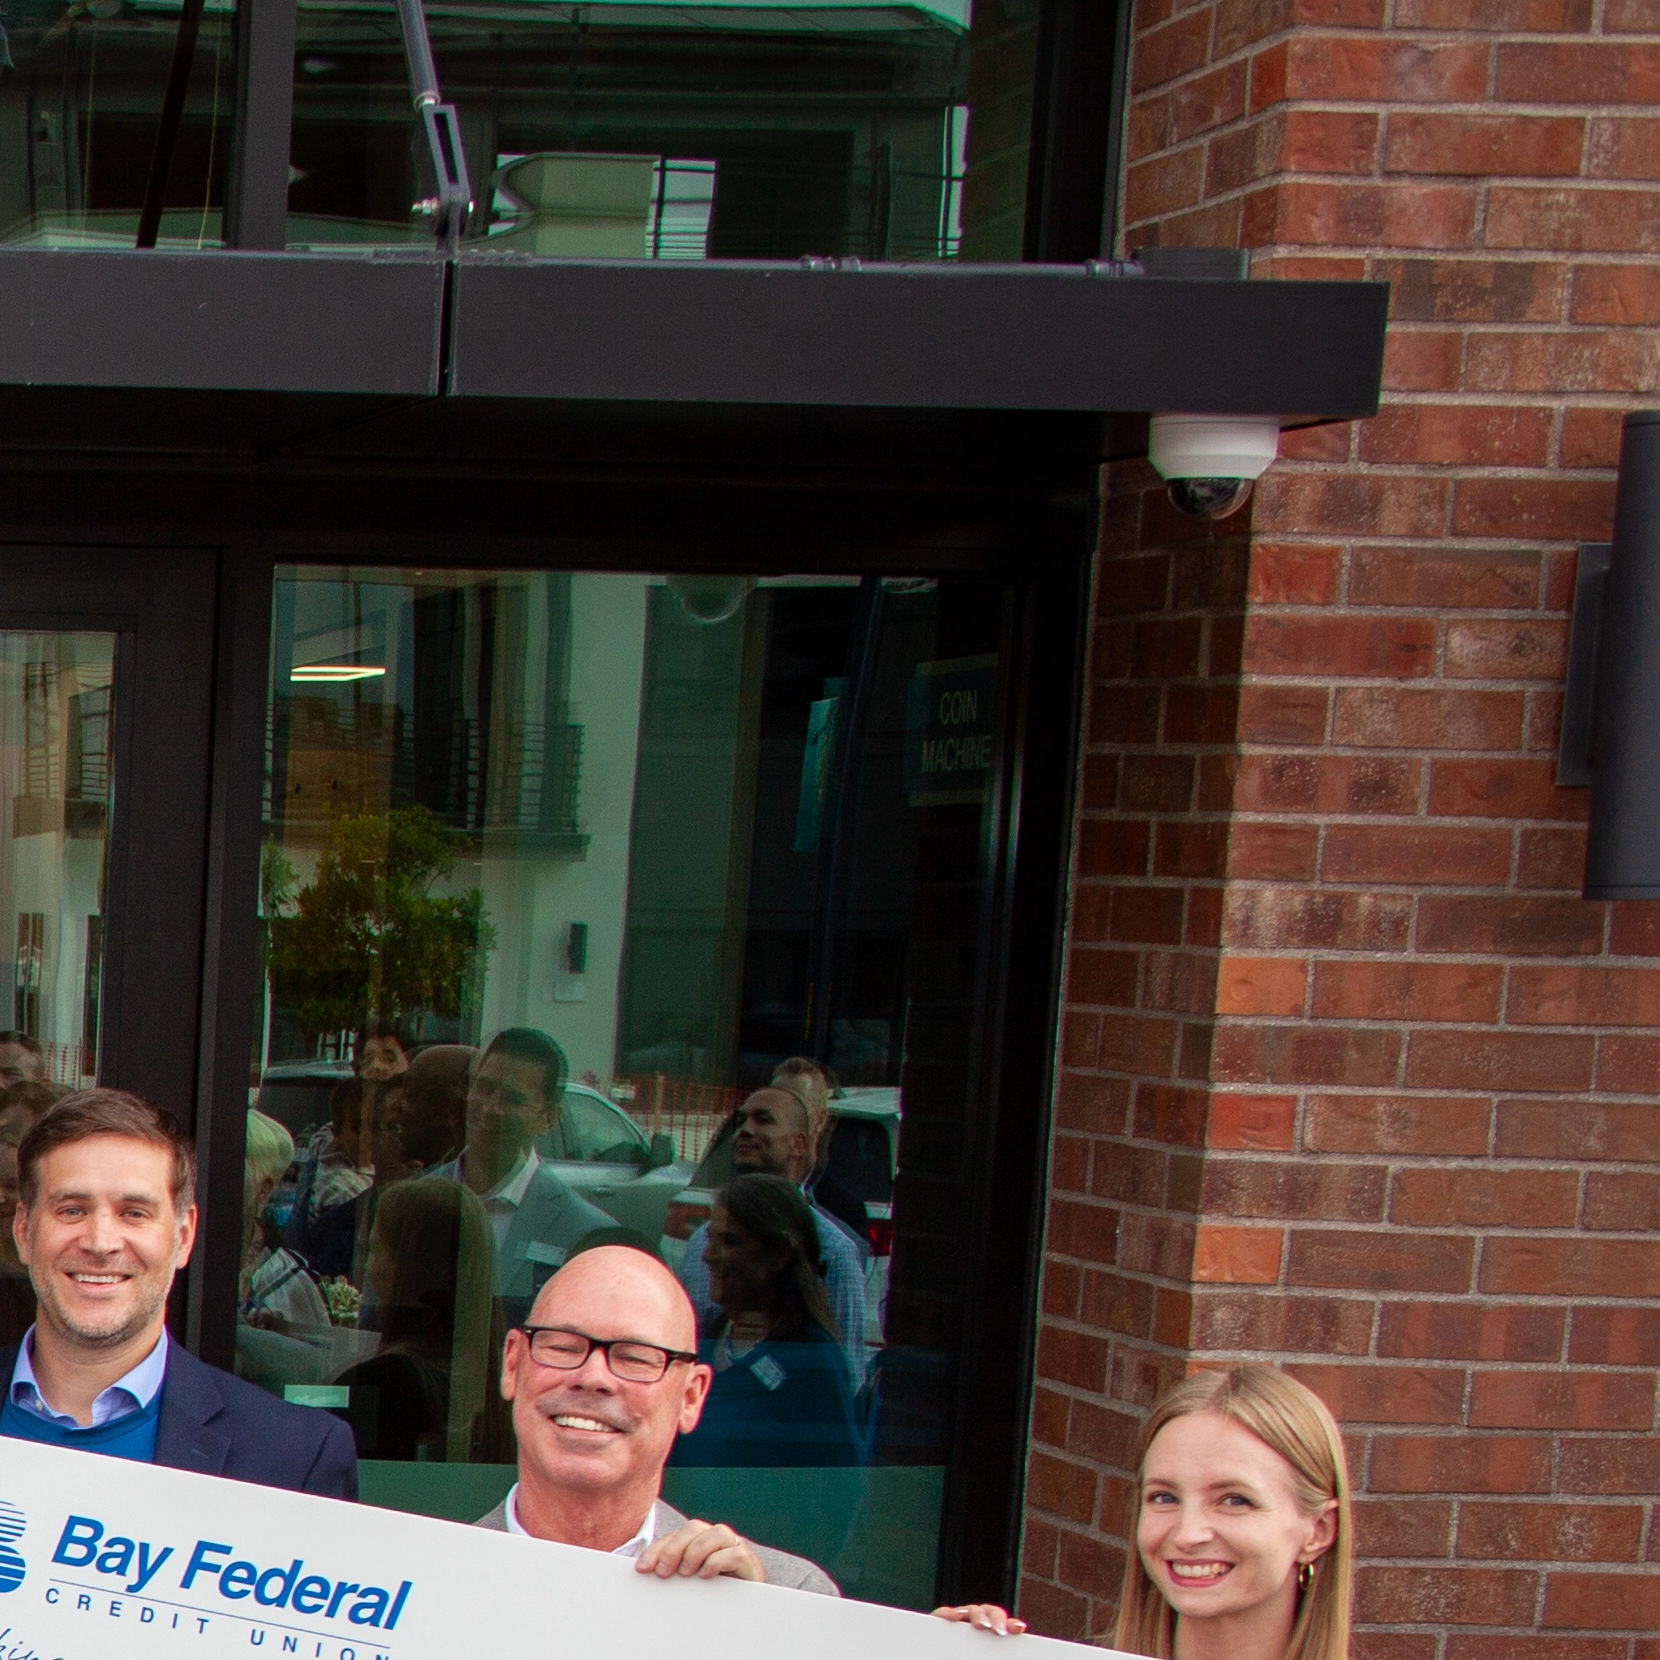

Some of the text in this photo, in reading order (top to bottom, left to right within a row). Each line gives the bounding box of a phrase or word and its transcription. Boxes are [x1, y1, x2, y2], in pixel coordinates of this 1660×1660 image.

[940, 689, 978, 725] COIN
[922, 735, 991, 772] MACHINE
[51, 1514, 412, 1631] Bay Federal
[45, 1588, 210, 1635] CREDIT
